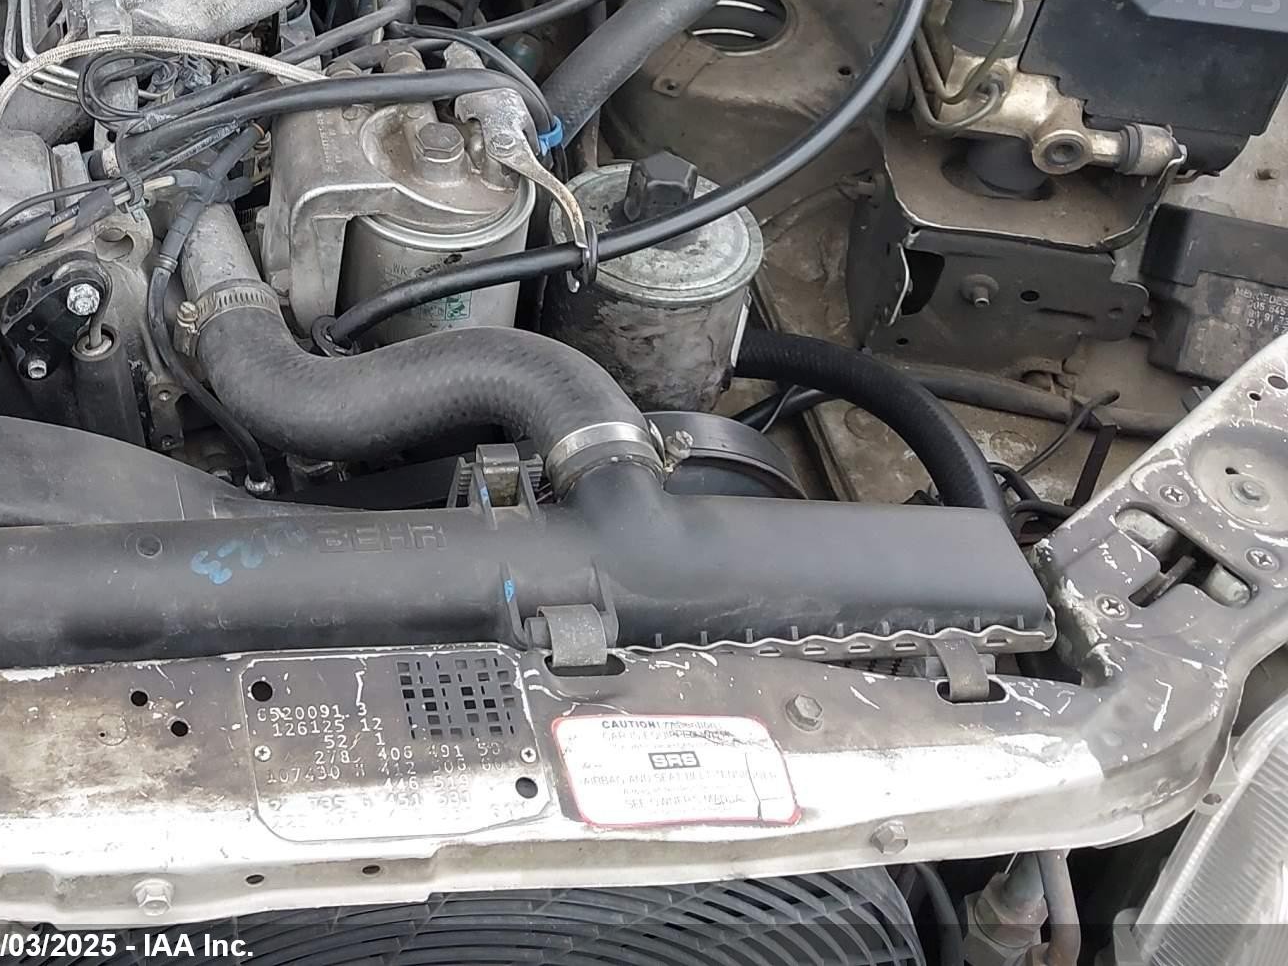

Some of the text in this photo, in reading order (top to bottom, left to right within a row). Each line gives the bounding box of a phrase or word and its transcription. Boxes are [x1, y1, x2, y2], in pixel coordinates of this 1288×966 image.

[318, 523, 449, 556] BEHR
[272, 716, 384, 737] 126125 12
[324, 732, 386, 750] 52 1
[378, 745, 413, 762] 406
[652, 753, 697, 767] SRS
